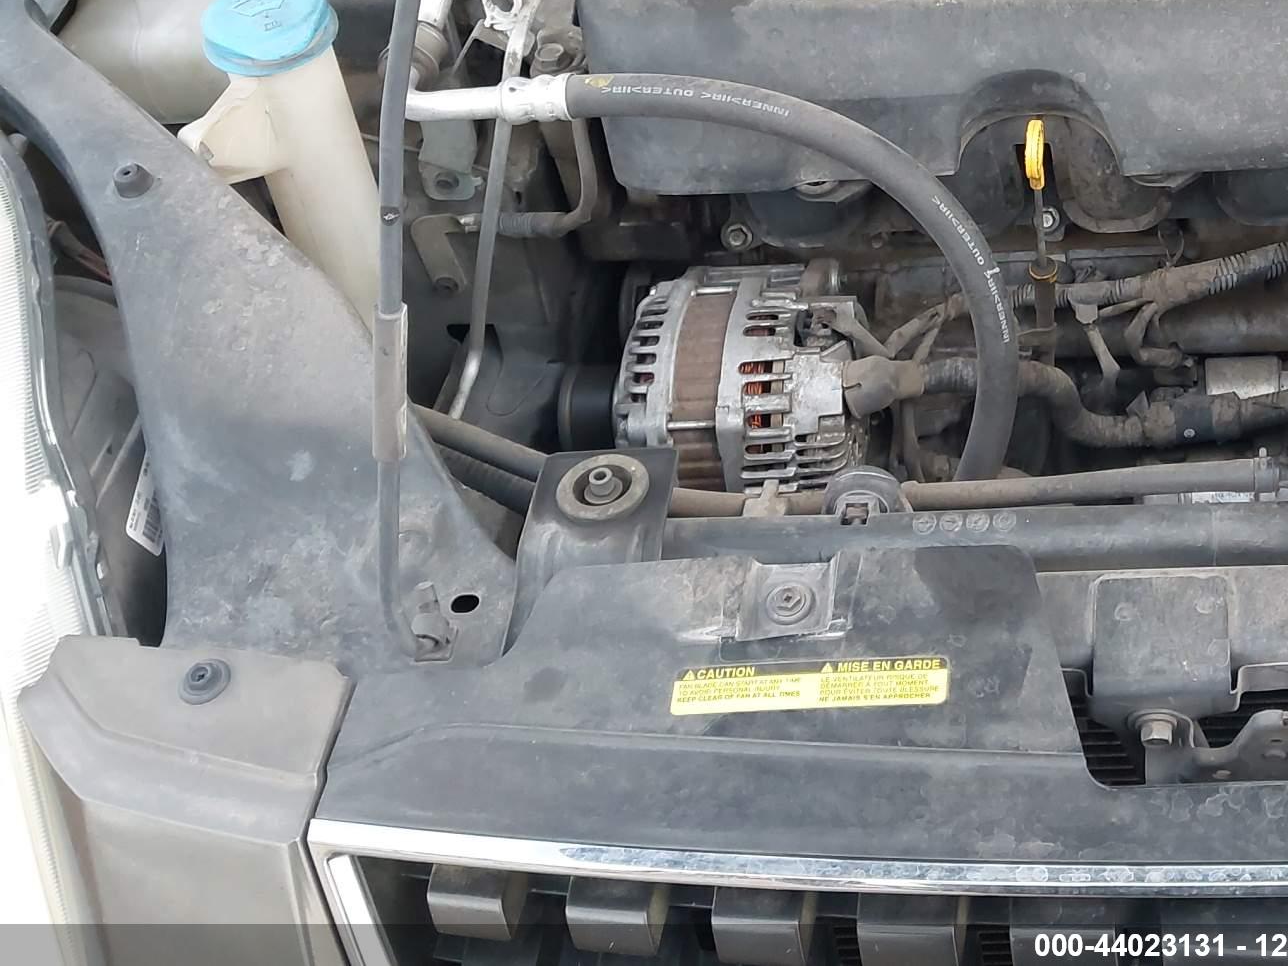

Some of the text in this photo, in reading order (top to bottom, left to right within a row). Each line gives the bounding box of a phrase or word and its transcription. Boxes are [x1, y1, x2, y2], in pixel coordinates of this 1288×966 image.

[697, 666, 756, 680] CAUTION
[837, 659, 941, 673] MISE EN GARDE
